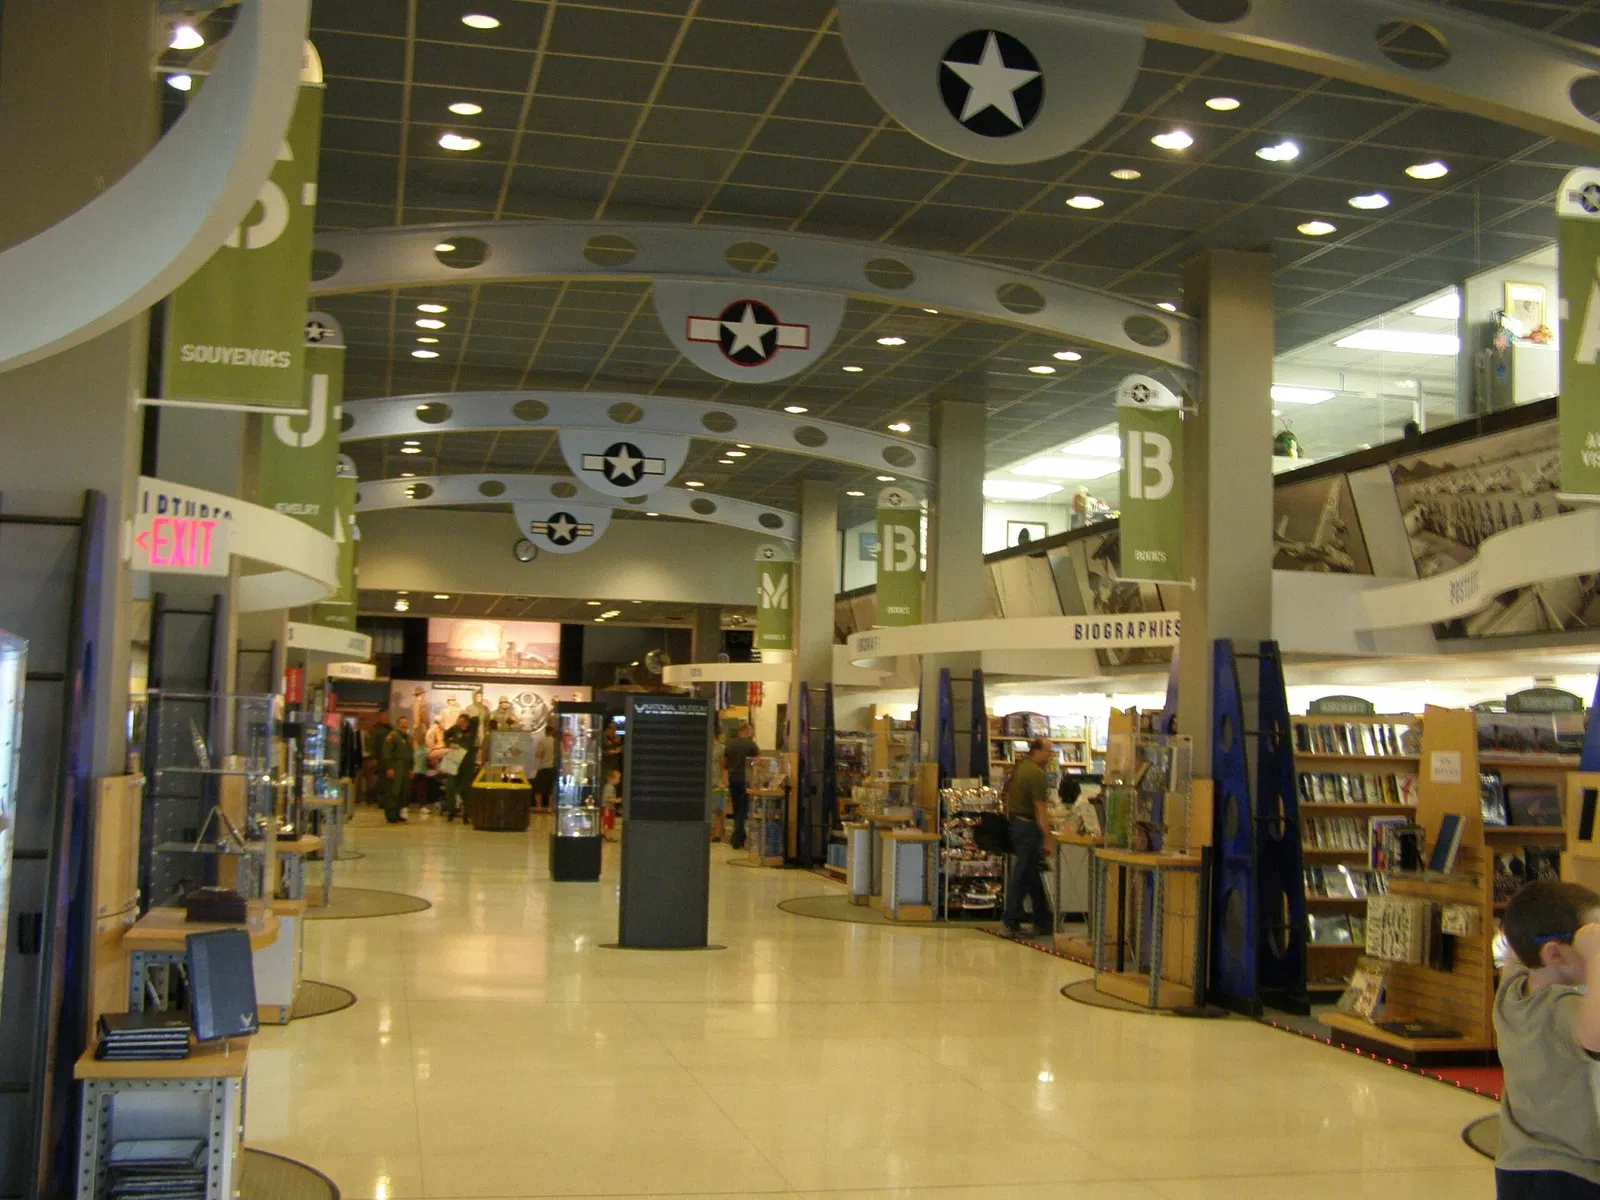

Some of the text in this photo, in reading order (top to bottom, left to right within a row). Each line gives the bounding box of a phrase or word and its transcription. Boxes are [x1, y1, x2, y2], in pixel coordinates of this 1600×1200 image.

[180, 344, 292, 369] SOUVENIRS
[272, 372, 329, 448] J
[1127, 430, 1175, 500] B
[149, 517, 217, 569] EXIT
[882, 524, 917, 572] B
[1134, 549, 1167, 563] BOOKS
[762, 572, 789, 609] M
[1074, 619, 1180, 641] BIOGRAPHIES
